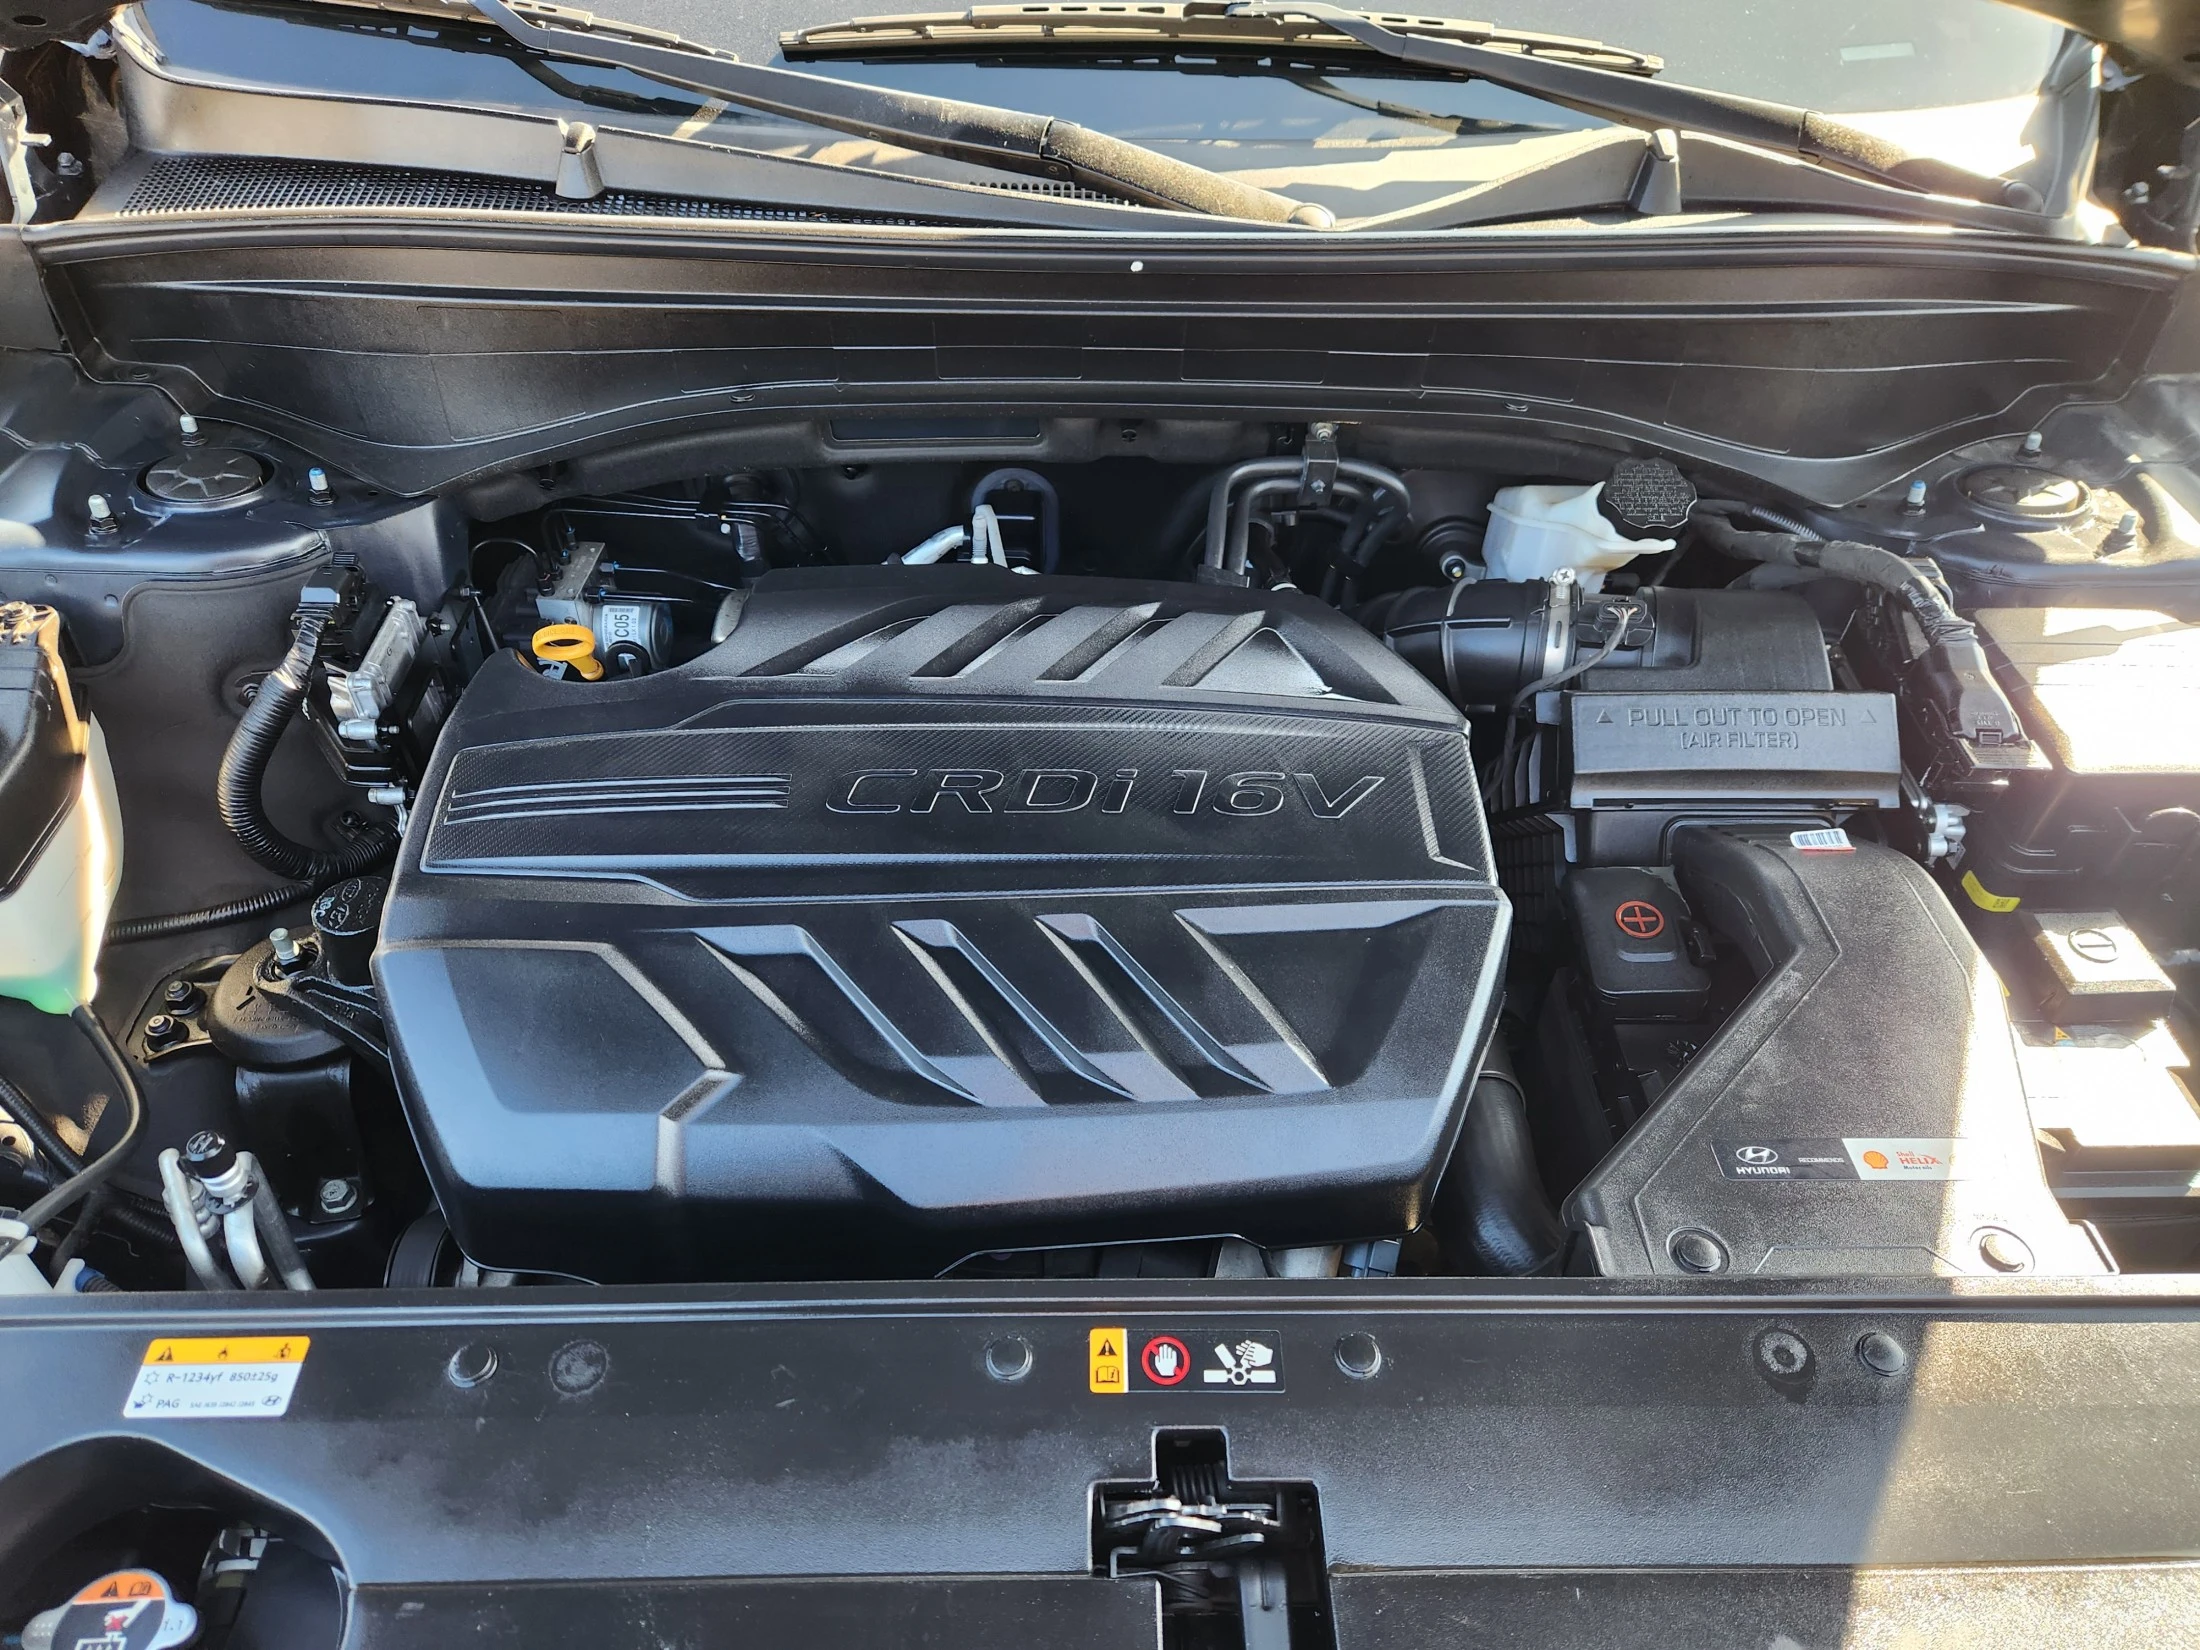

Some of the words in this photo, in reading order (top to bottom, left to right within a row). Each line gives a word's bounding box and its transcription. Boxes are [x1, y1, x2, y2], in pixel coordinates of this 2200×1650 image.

[614, 614, 630, 638] C05
[1627, 708, 1688, 726] PULL
[1694, 708, 1741, 726] OUT
[1748, 708, 1778, 726] TO
[1783, 708, 1847, 727] OPEN
[824, 767, 1136, 814] CRDi
[1171, 769, 1386, 819] 16V
[1899, 1154, 1943, 1165] HELIX
[1736, 1166, 1791, 1175] HYUNDAI
[166, 1371, 223, 1384] R-1234yf
[229, 1371, 279, 1383] 850±25g
[156, 1399, 180, 1408] PAG
